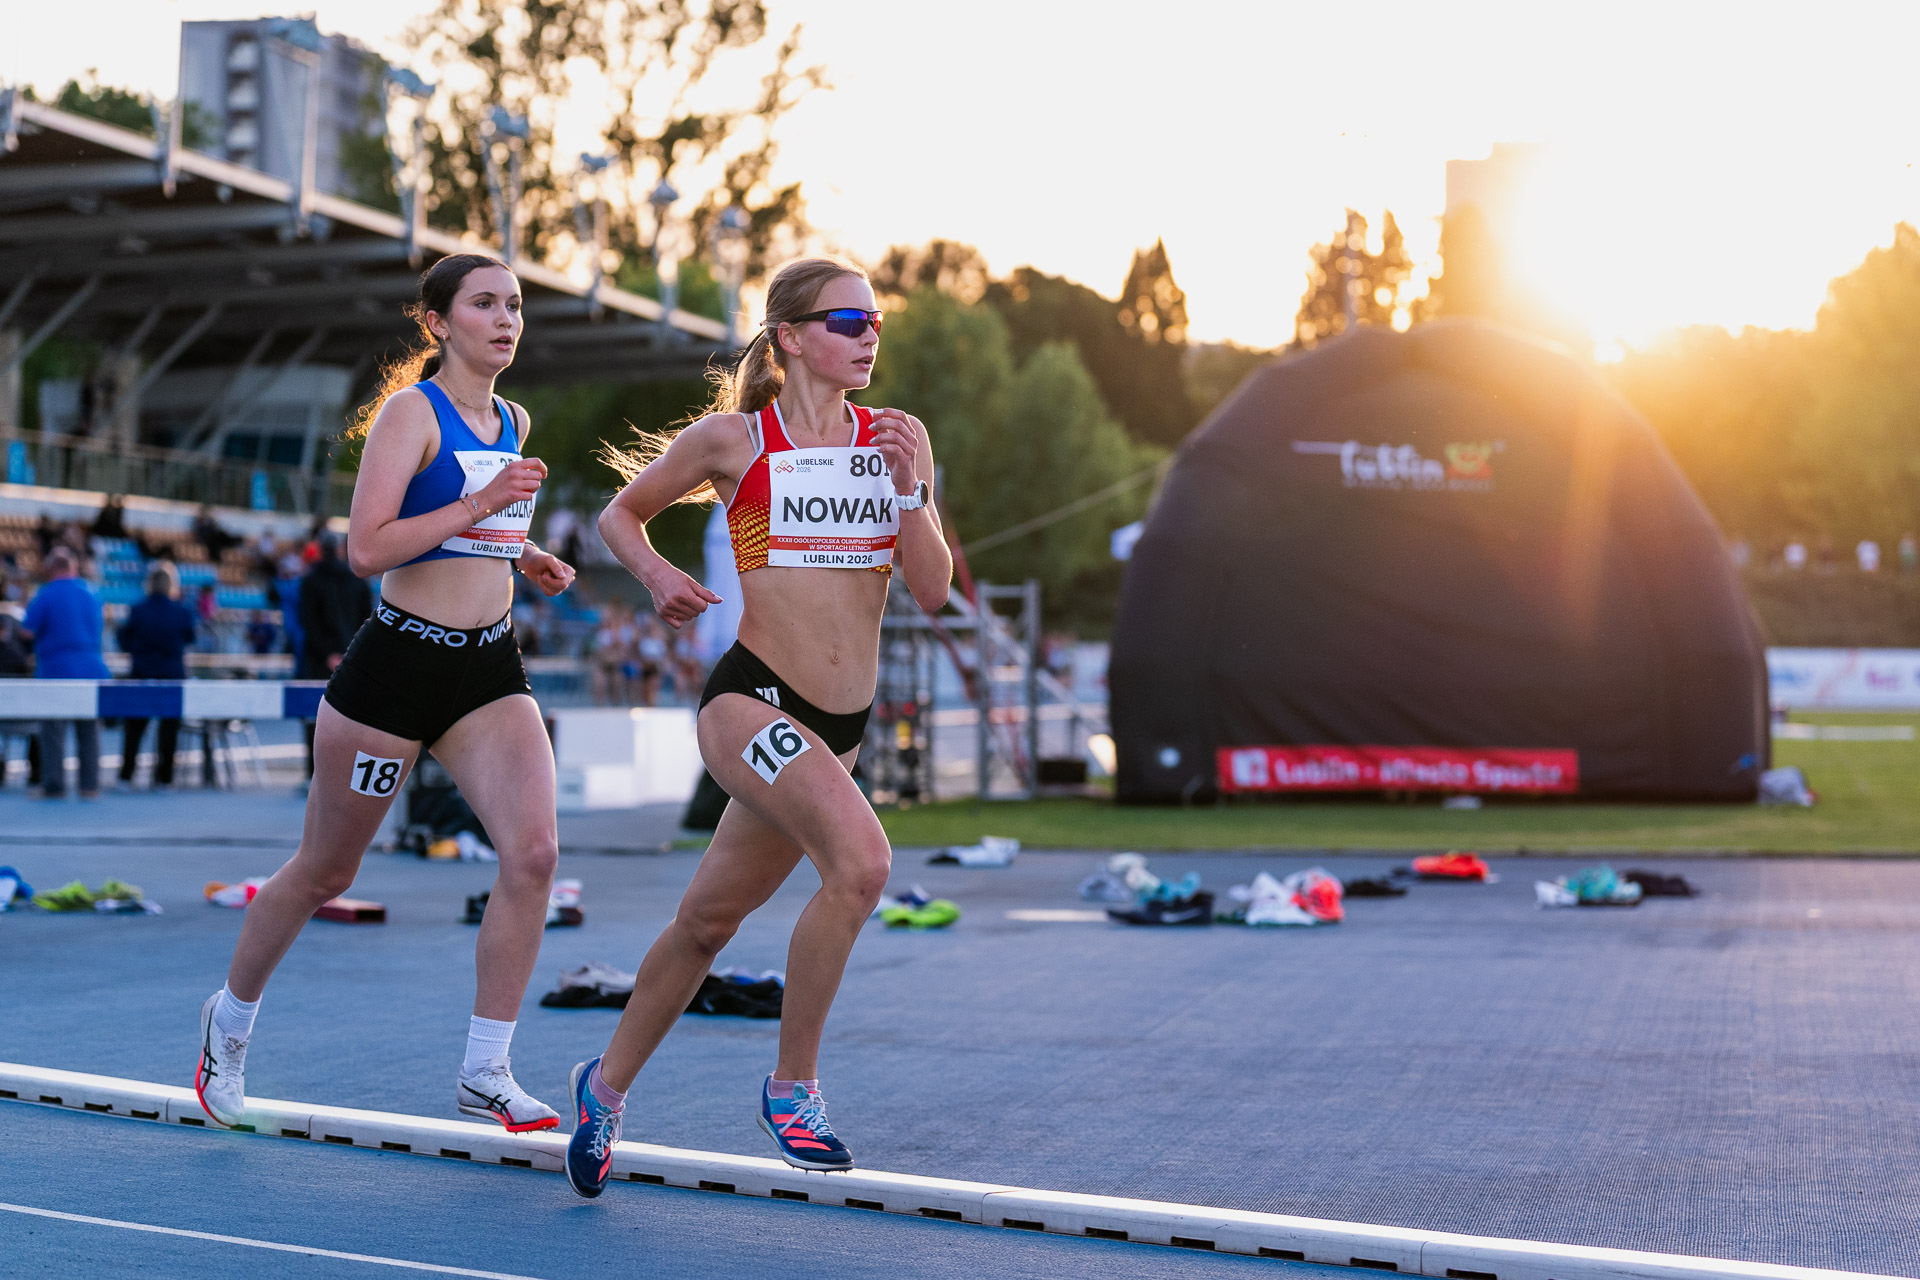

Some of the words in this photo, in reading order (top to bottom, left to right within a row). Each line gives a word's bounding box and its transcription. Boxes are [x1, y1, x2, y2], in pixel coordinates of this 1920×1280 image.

[783, 496, 893, 524] NOWAK
[471, 542, 504, 554] LUBLIN
[504, 545, 522, 554] 2026
[793, 536, 840, 544] OGÓLNOPOLSKA
[803, 554, 844, 564] LUBLIN
[846, 554, 873, 564] 2026
[398, 618, 468, 648] PRO
[752, 722, 803, 775] 16
[356, 758, 400, 795] 18
